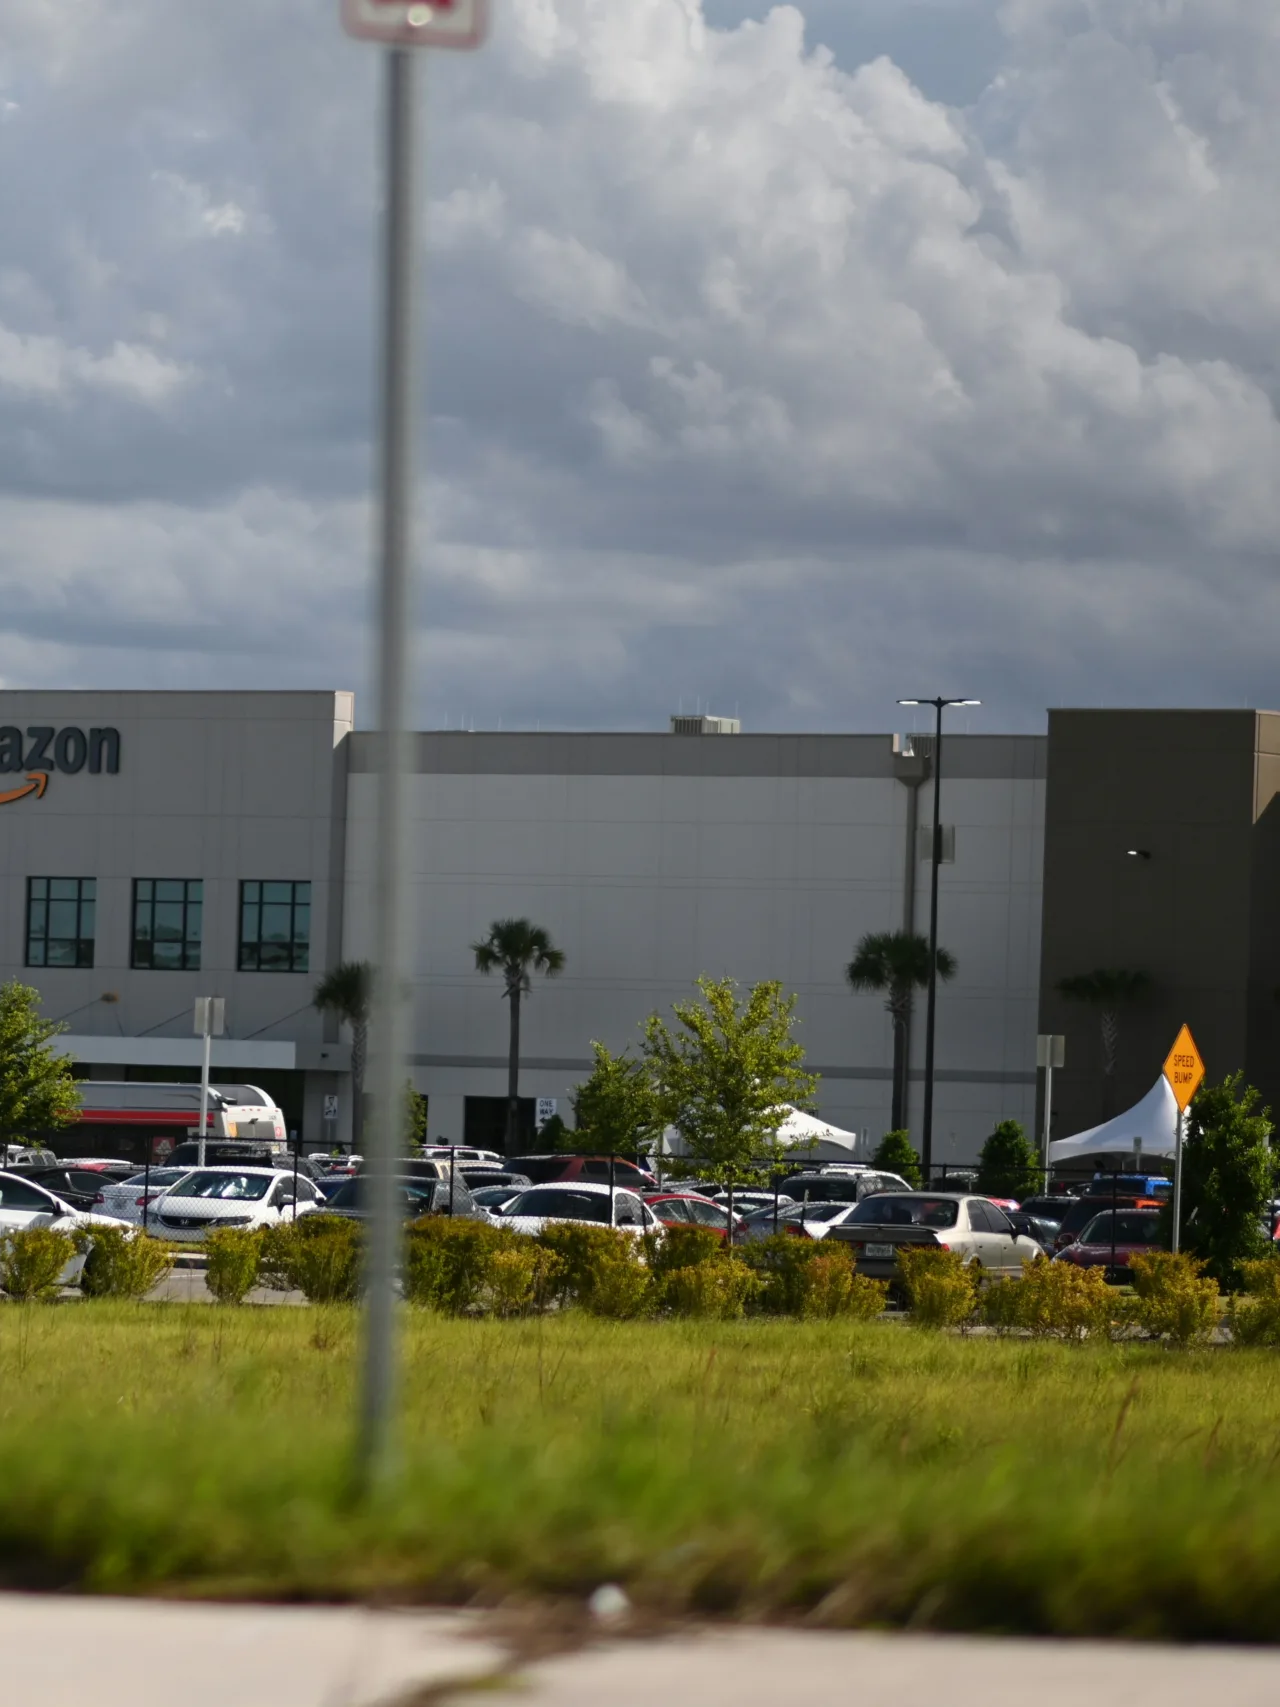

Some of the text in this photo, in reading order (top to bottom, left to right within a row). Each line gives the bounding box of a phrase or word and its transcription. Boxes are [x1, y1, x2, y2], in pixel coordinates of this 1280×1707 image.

[1173, 1054, 1195, 1068] SPEED
[1174, 1071, 1193, 1085] BUMP
[539, 1100, 554, 1108] ONE
